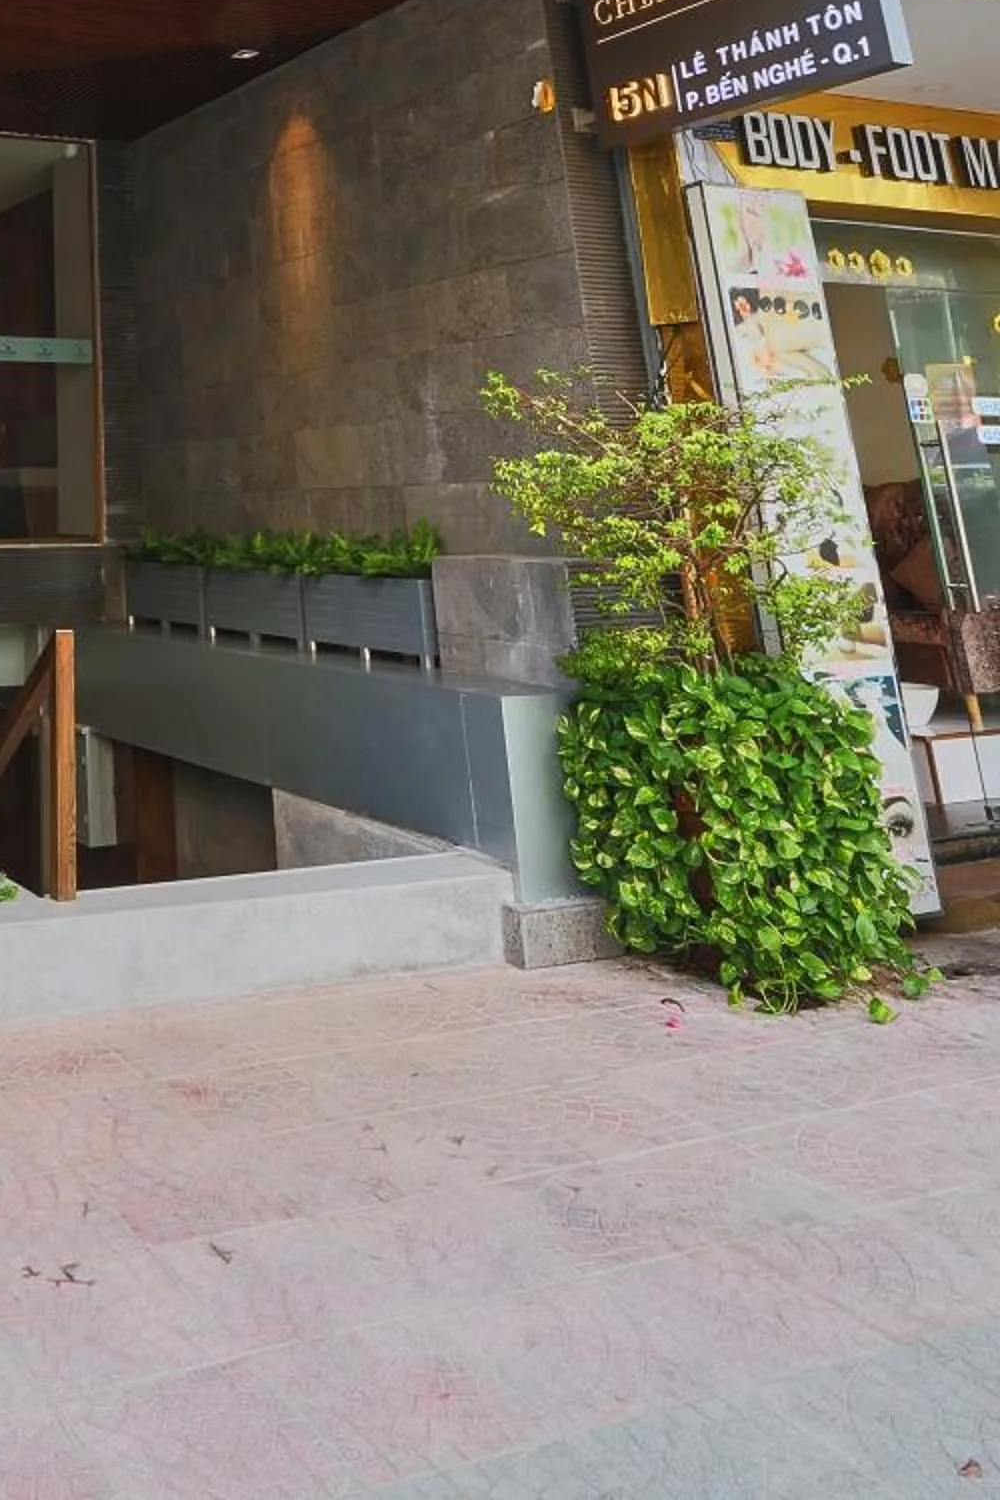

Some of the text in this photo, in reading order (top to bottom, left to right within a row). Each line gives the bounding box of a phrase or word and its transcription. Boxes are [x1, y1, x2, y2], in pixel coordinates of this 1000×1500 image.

[679, 0, 864, 79] LÊ THÁNH TÔN
[752, 47, 818, 91] NGHÉ
[832, 35, 872, 66] Q.1
[743, 110, 837, 172] BODY
[864, 123, 954, 185] FOOT
[961, 135, 1000, 189] M
